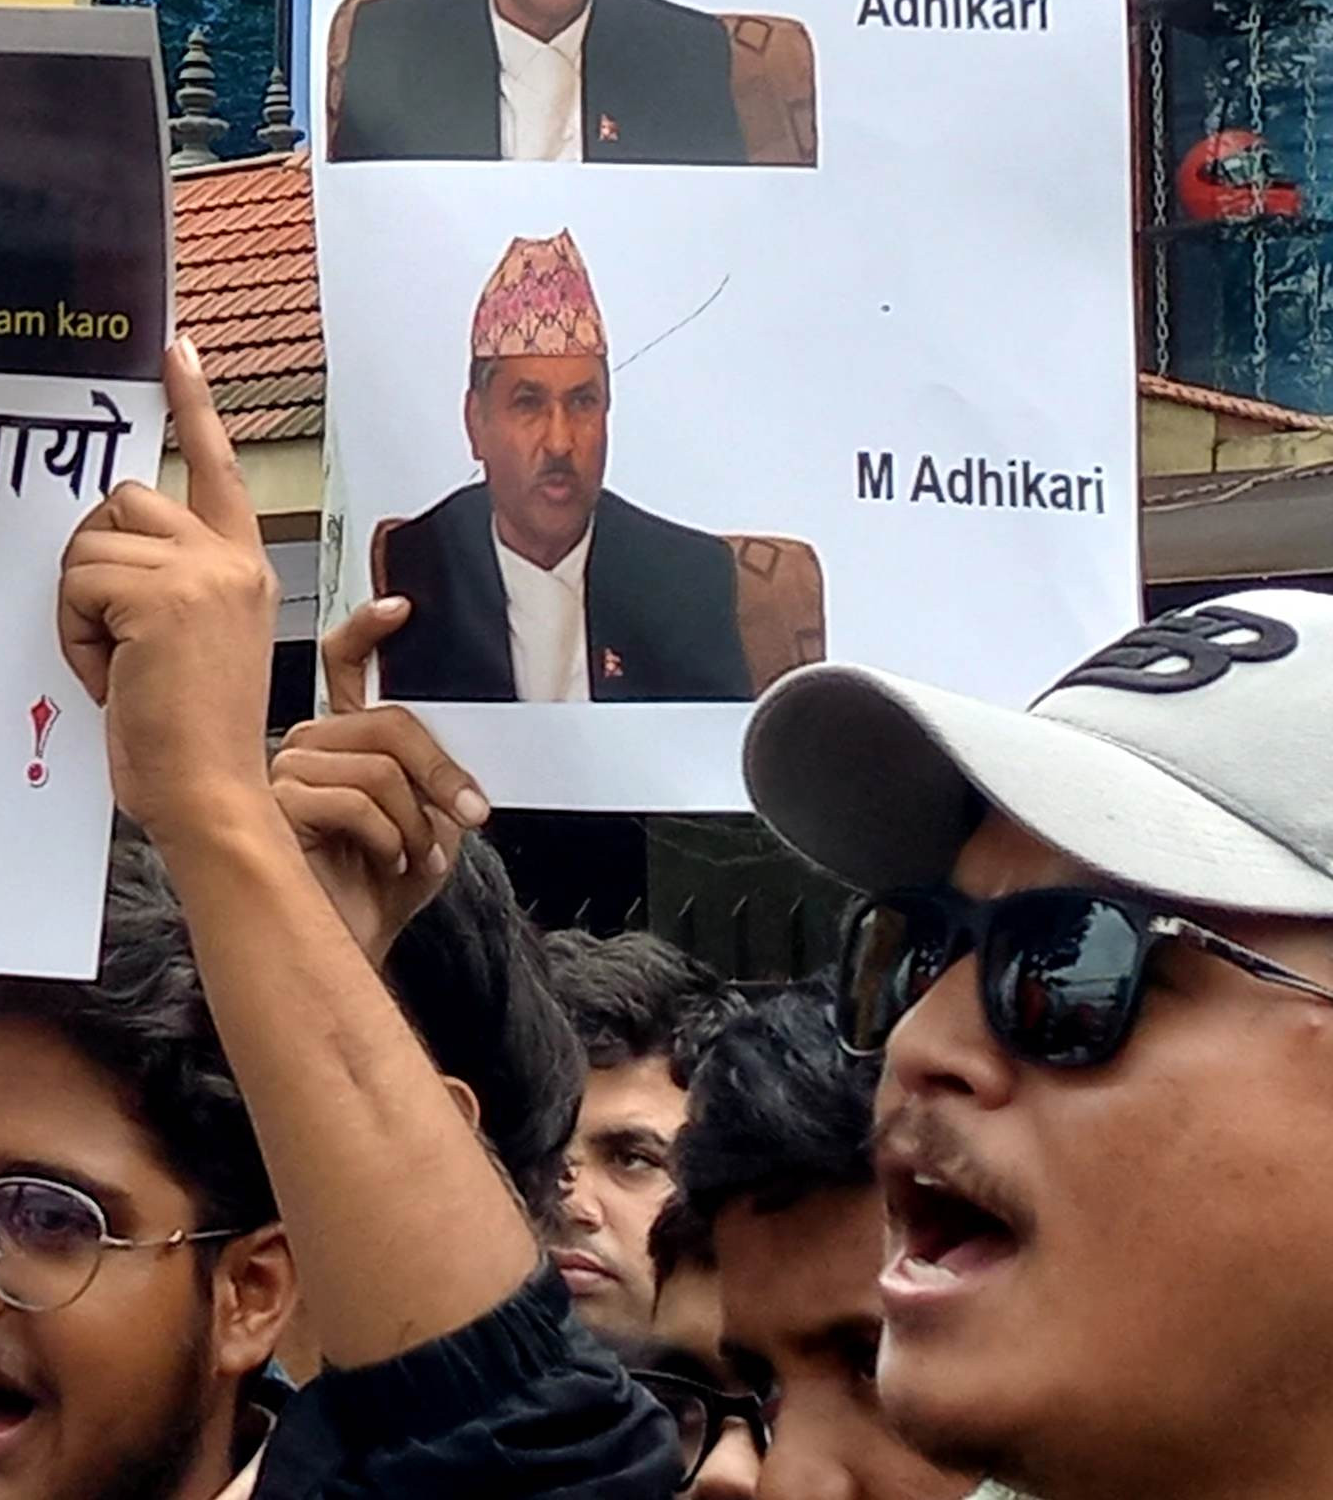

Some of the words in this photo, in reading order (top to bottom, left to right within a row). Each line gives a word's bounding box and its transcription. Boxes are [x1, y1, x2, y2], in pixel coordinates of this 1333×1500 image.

[57, 303, 130, 341] karo
[858, 452, 894, 500] M
[910, 456, 1104, 514] Adhikari
